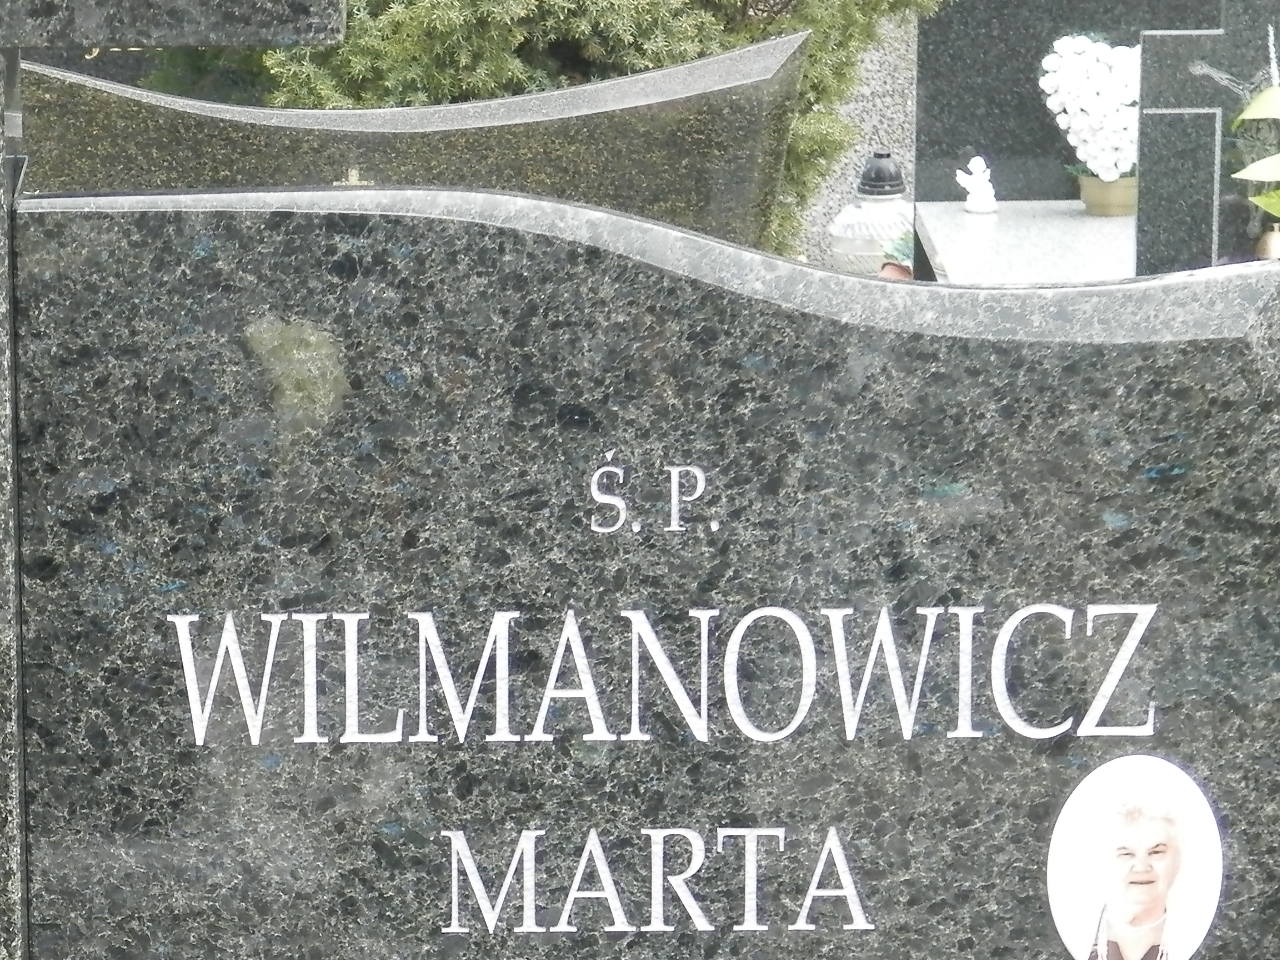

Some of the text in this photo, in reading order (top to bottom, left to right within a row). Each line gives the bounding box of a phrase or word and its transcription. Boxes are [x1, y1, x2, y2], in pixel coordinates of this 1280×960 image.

[588, 449, 720, 533] Ś. P.
[166, 602, 1160, 747] WILMANOWICZ
[440, 826, 875, 936] MARTA
